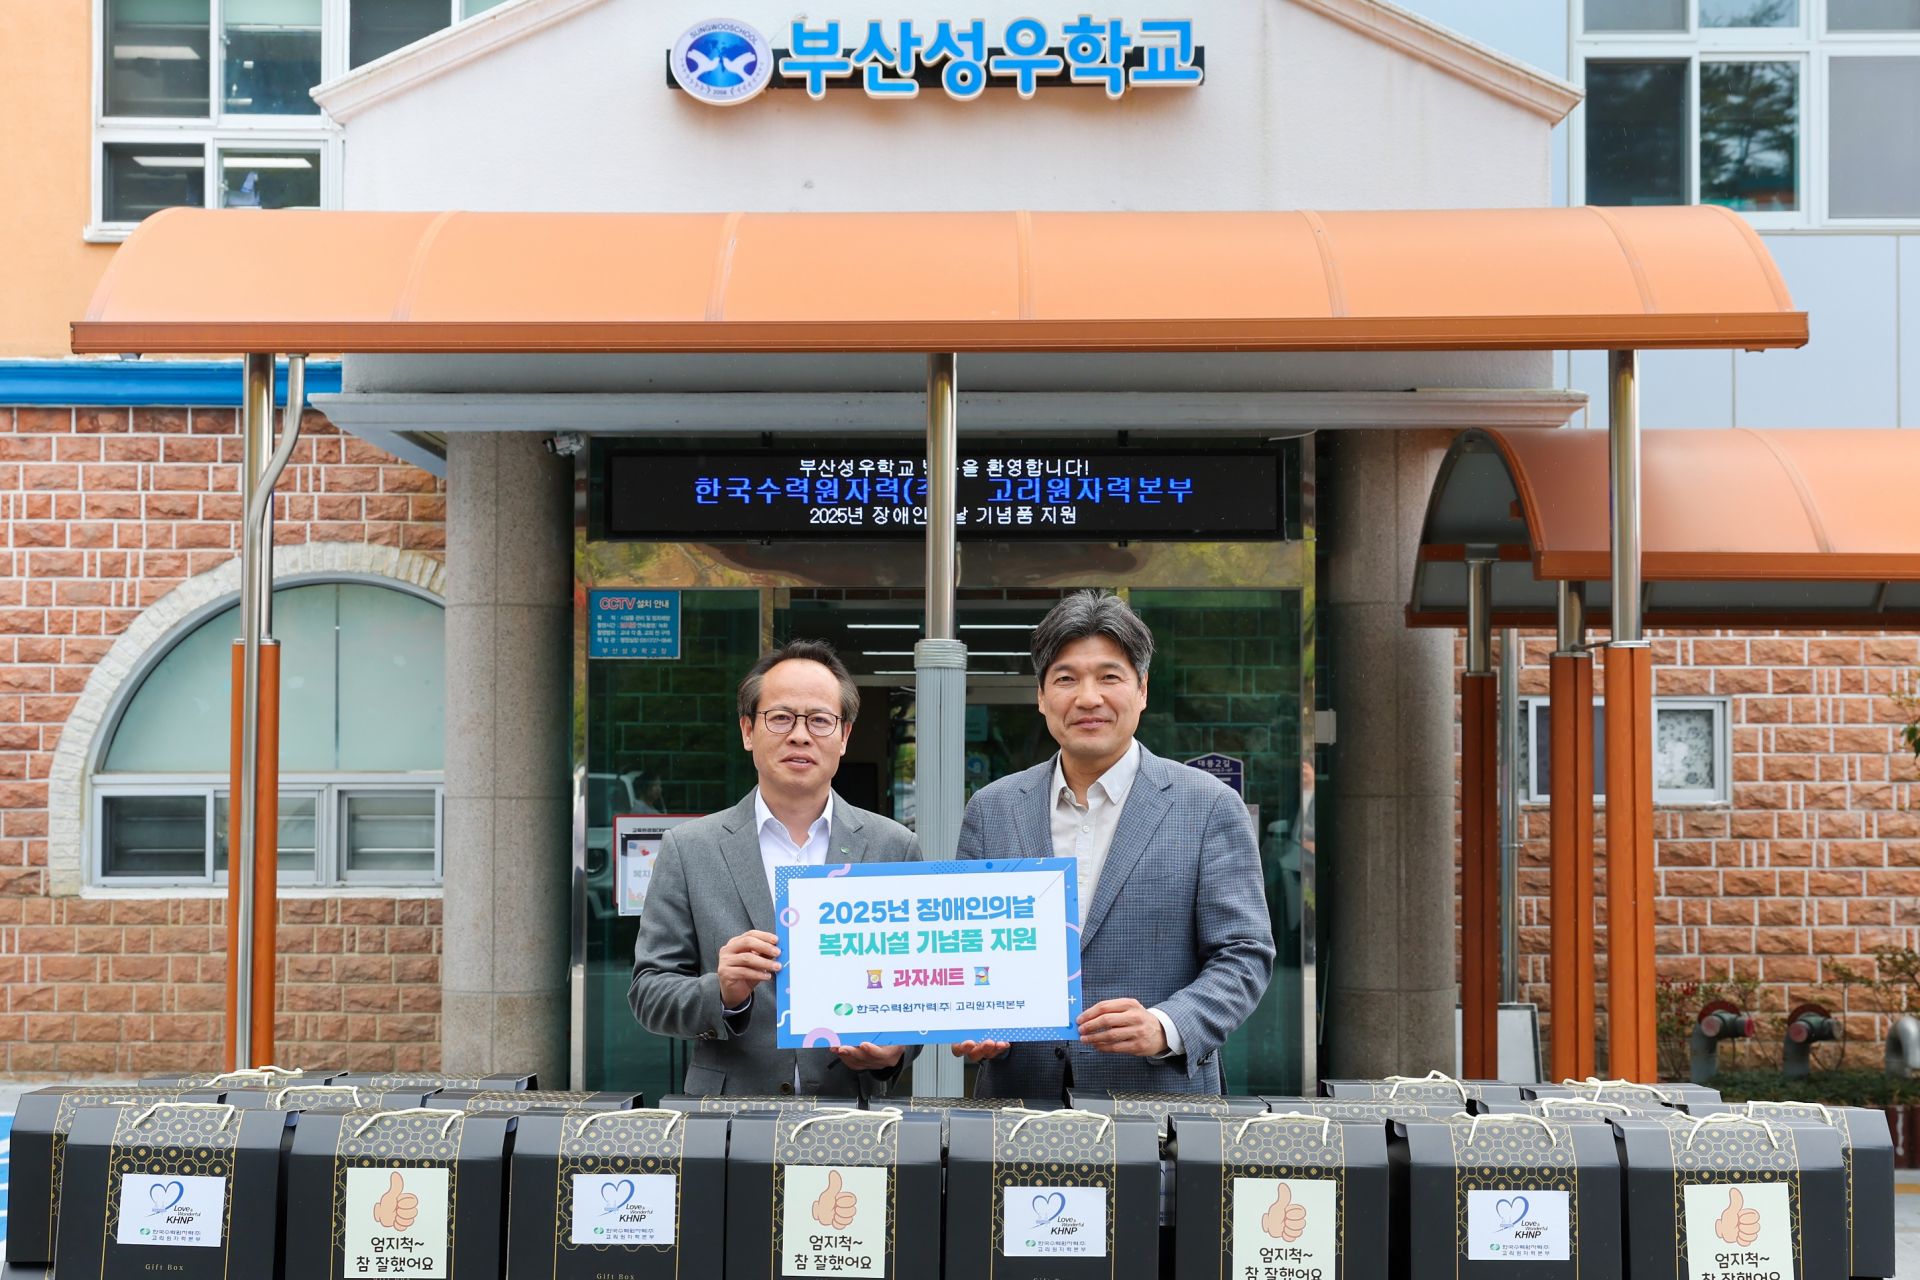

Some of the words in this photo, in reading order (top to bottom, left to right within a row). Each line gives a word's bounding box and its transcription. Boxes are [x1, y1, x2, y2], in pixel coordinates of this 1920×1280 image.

[779, 14, 1203, 99] 부산성우학교
[799, 459, 915, 477] 부산성우학교
[986, 459, 1089, 477] 환영합니다!
[987, 477, 1193, 504] 고리원자력본부
[809, 507, 863, 524] 2025년
[976, 506, 1034, 525] 기념품
[1040, 506, 1077, 525] 지원
[600, 597, 636, 610] CCTV
[818, 900, 910, 924] 2025년
[916, 895, 1035, 922] 장애인의날
[818, 930, 910, 956] 복지시설
[916, 929, 983, 954] 기념품
[990, 927, 1037, 952] 지원
[893, 967, 965, 988] 과자세트
[955, 1000, 1025, 1011] 고리원자력본부
[166, 1216, 194, 1224] KHNP
[619, 1214, 646, 1222] KHNP
[1050, 1227, 1078, 1235] KHNP
[370, 1236, 424, 1253] 엄지척~
[809, 1235, 863, 1251] 엄지척~
[356, 1256, 370, 1272] 참
[375, 1256, 433, 1272] 잘했어요
[794, 1254, 808, 1270] 참
[814, 1254, 872, 1270] 잘했어요
[1260, 1248, 1313, 1264] 엄지척~
[1715, 1252, 1770, 1268] 엄지척~
[1245, 1266, 1259, 1280] 참
[1264, 1266, 1322, 1280] 잘했어요
